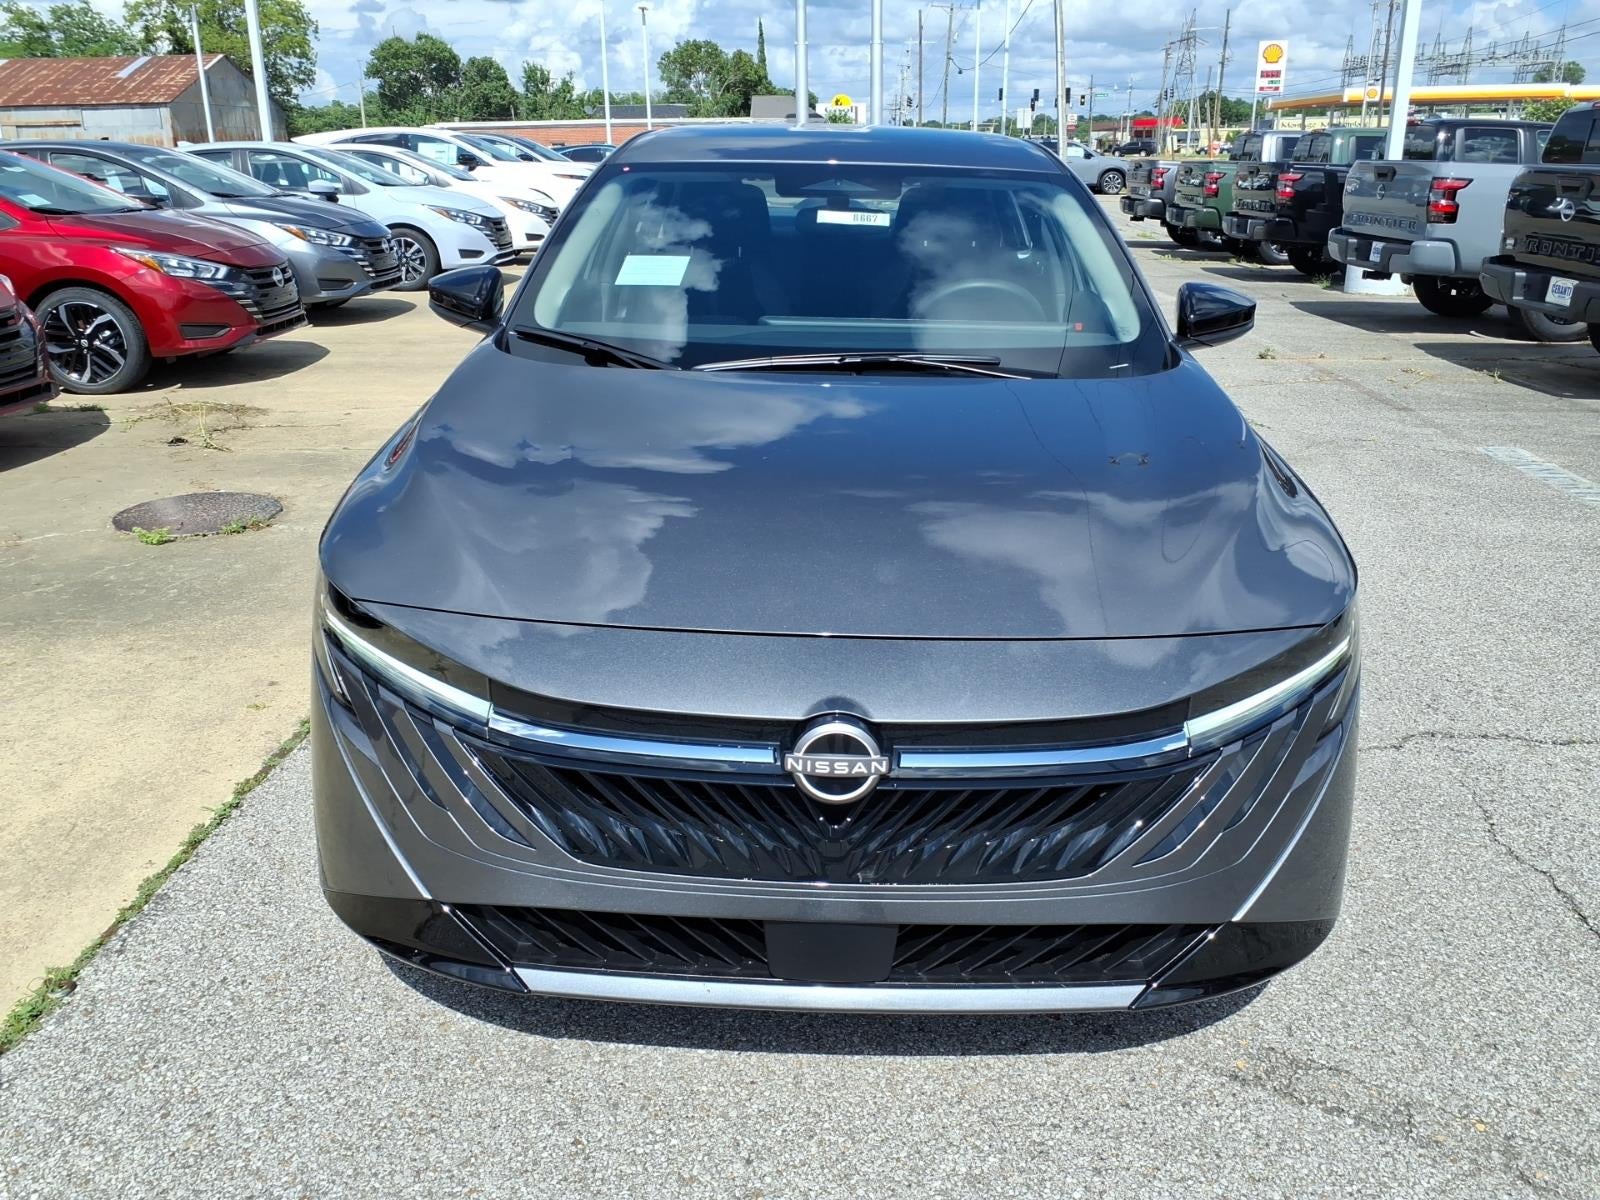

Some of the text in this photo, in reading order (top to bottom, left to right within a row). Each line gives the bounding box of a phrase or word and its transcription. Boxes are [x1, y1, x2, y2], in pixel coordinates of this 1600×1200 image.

[1352, 213, 1417, 231] FRONTIER
[1520, 237, 1600, 264] RONTI
[786, 757, 887, 774] NISSAN
